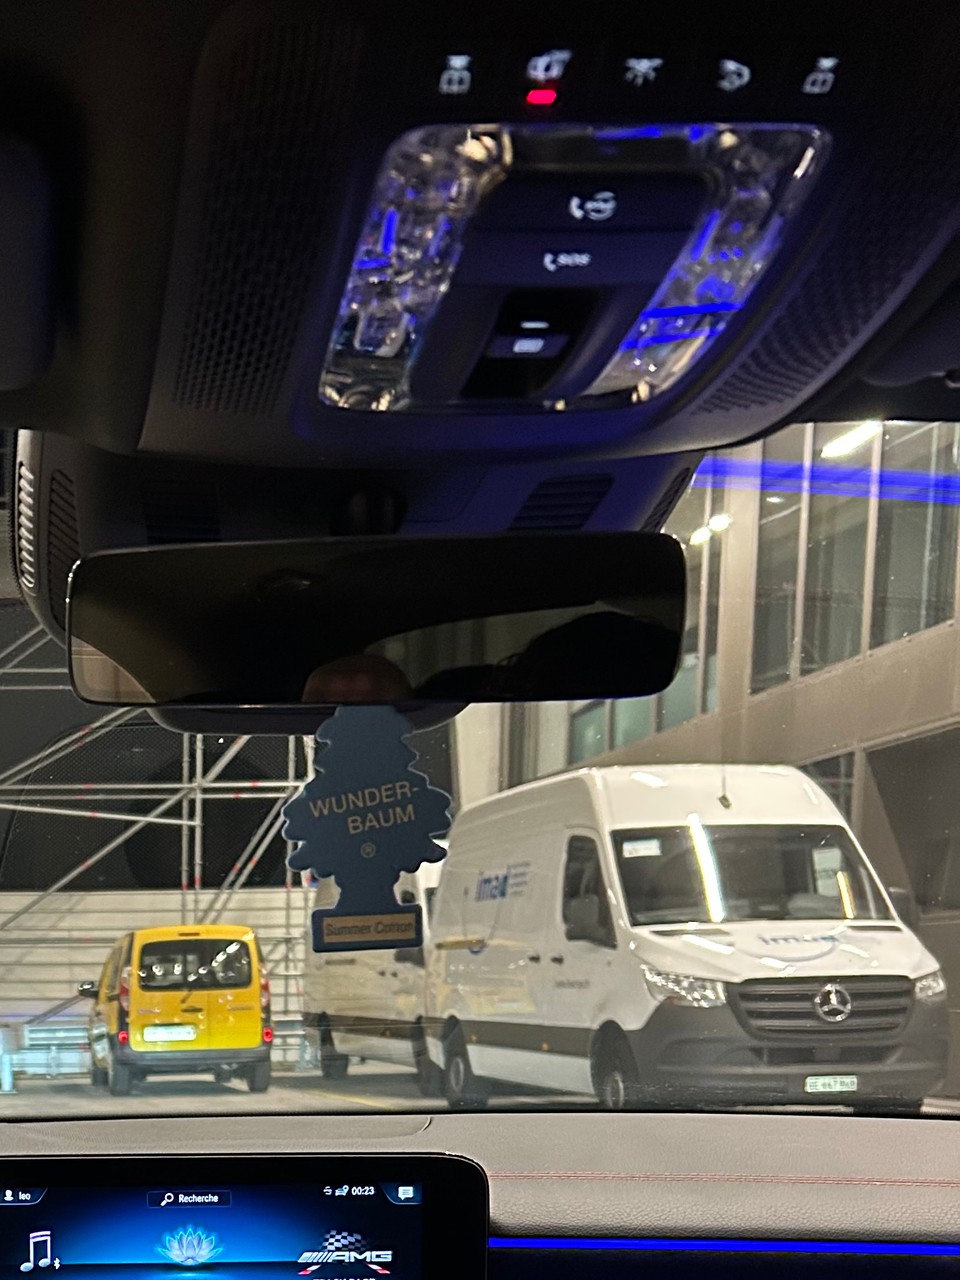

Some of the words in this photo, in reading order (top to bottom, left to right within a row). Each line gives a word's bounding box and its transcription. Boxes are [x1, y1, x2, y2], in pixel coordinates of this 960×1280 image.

[309, 781, 420, 818] WUNDER-
[347, 803, 416, 835] BAUM
[326, 922, 371, 937] Summer
[376, 921, 414, 934] Cotton
[18, 1190, 31, 1201] leo
[351, 1186, 375, 1196] 00:23
[178, 1193, 219, 1204] Recherche
